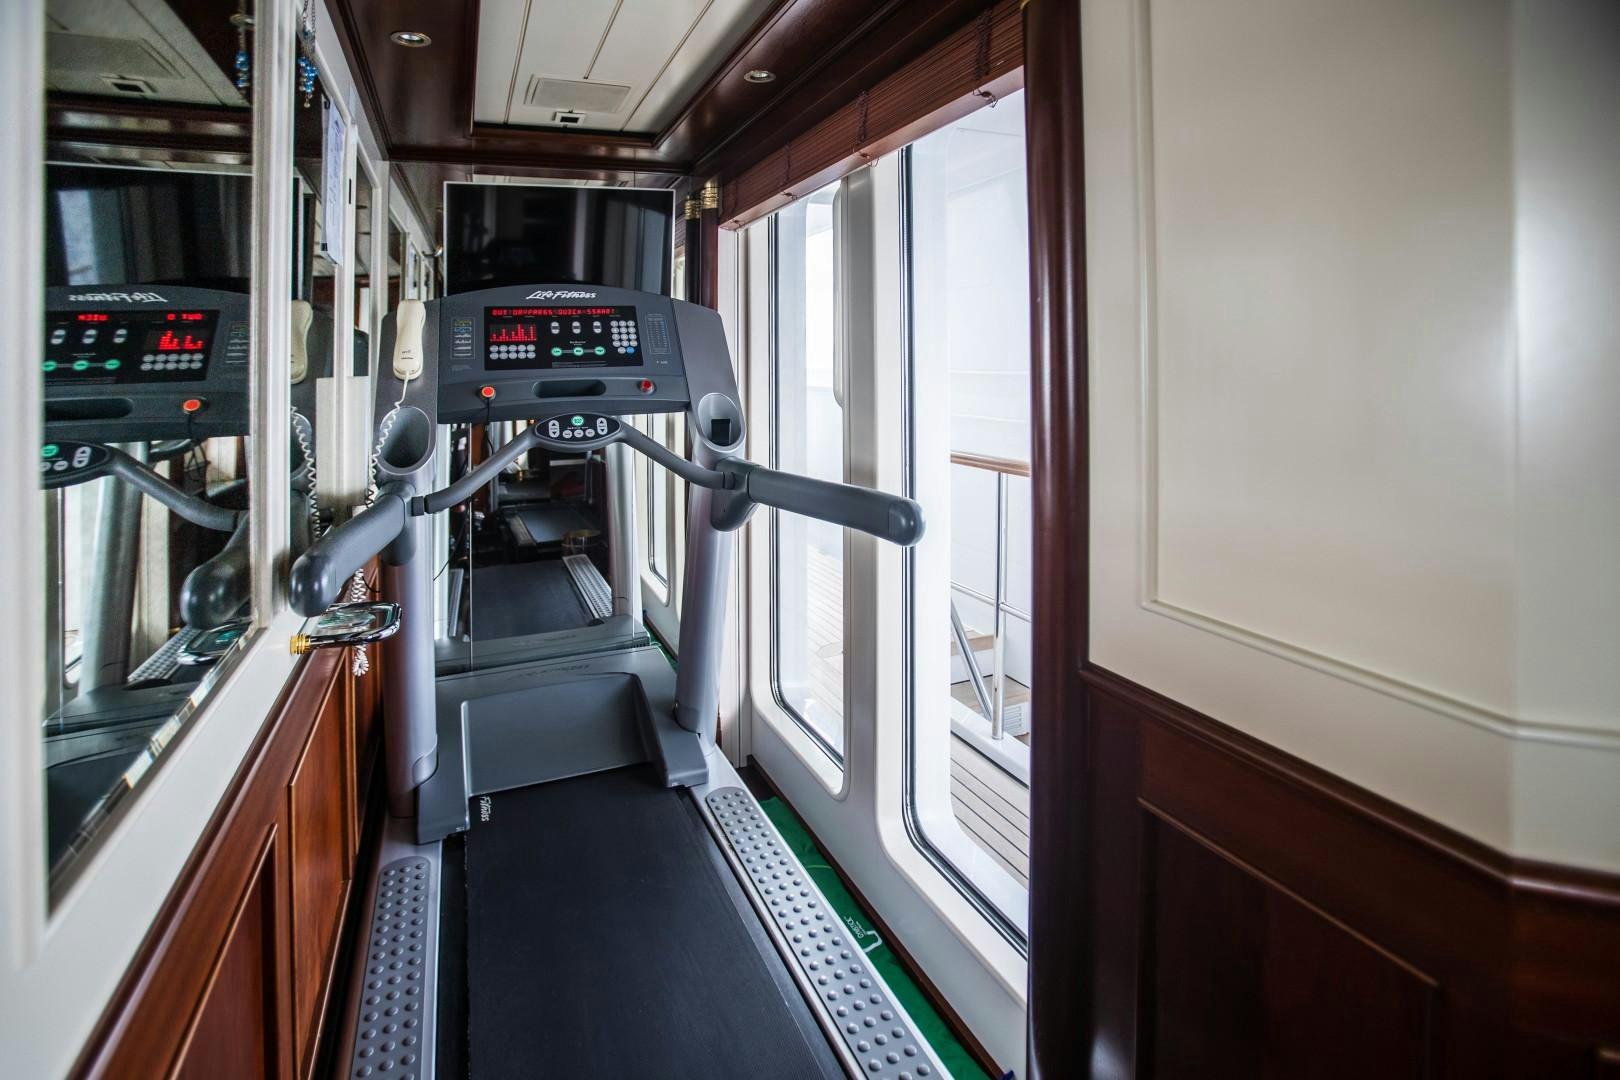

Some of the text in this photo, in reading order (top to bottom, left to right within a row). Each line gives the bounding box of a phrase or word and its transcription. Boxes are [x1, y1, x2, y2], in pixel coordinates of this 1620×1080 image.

[525, 290, 597, 300] Life Fitness
[479, 796, 492, 821] Fitness
